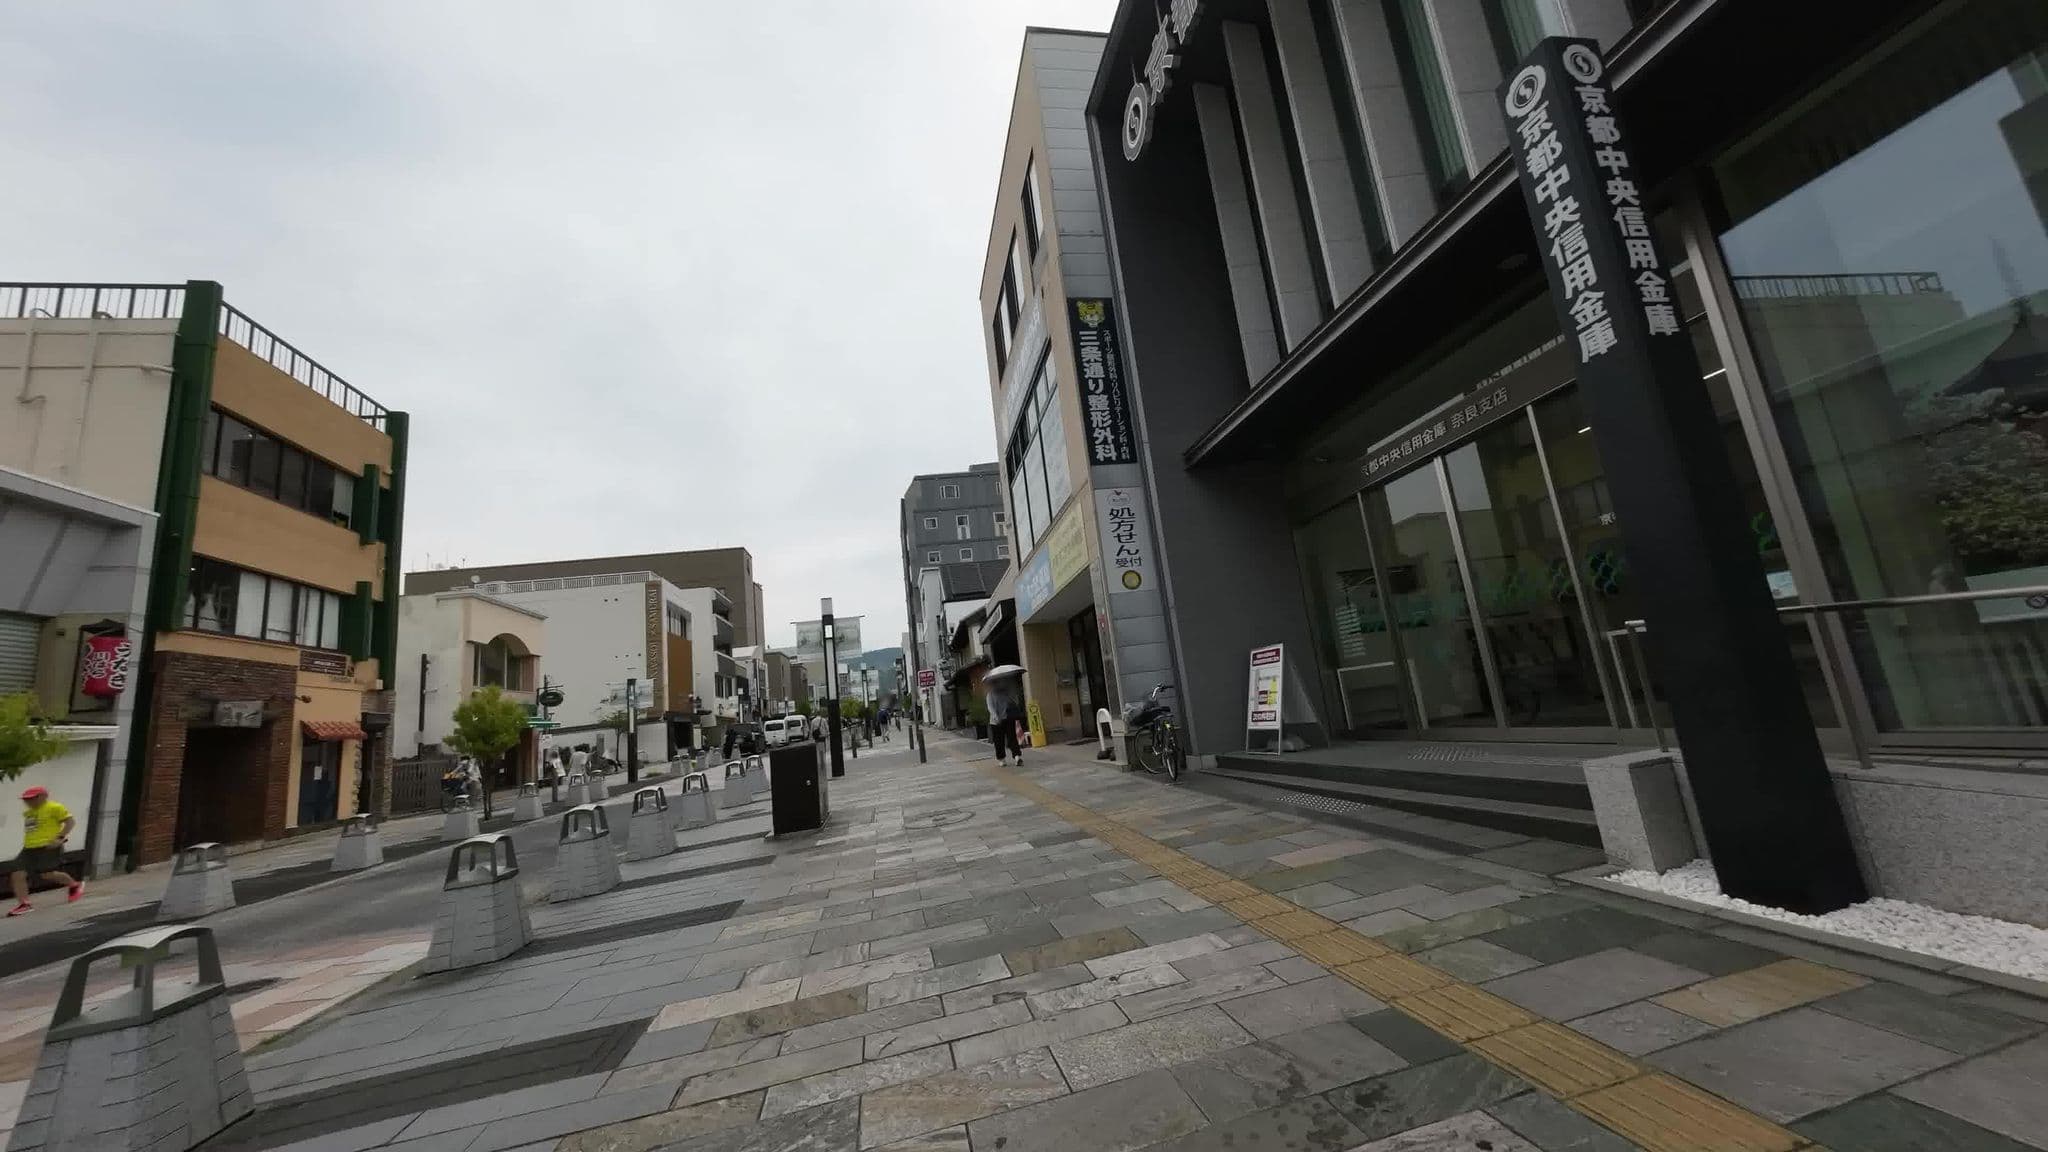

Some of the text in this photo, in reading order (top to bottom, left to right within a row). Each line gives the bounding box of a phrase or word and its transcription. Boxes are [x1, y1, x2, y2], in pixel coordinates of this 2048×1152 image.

[1516, 101, 1617, 363] 京都中央信用金庫
[1575, 85, 1679, 335] 京都中央信用金庫
[1079, 329, 1117, 462] 三条通り整形外科
[1450, 386, 1508, 429] 奈良支店
[1109, 507, 1139, 556] 処方せん
[1115, 556, 1143, 568] 受付
